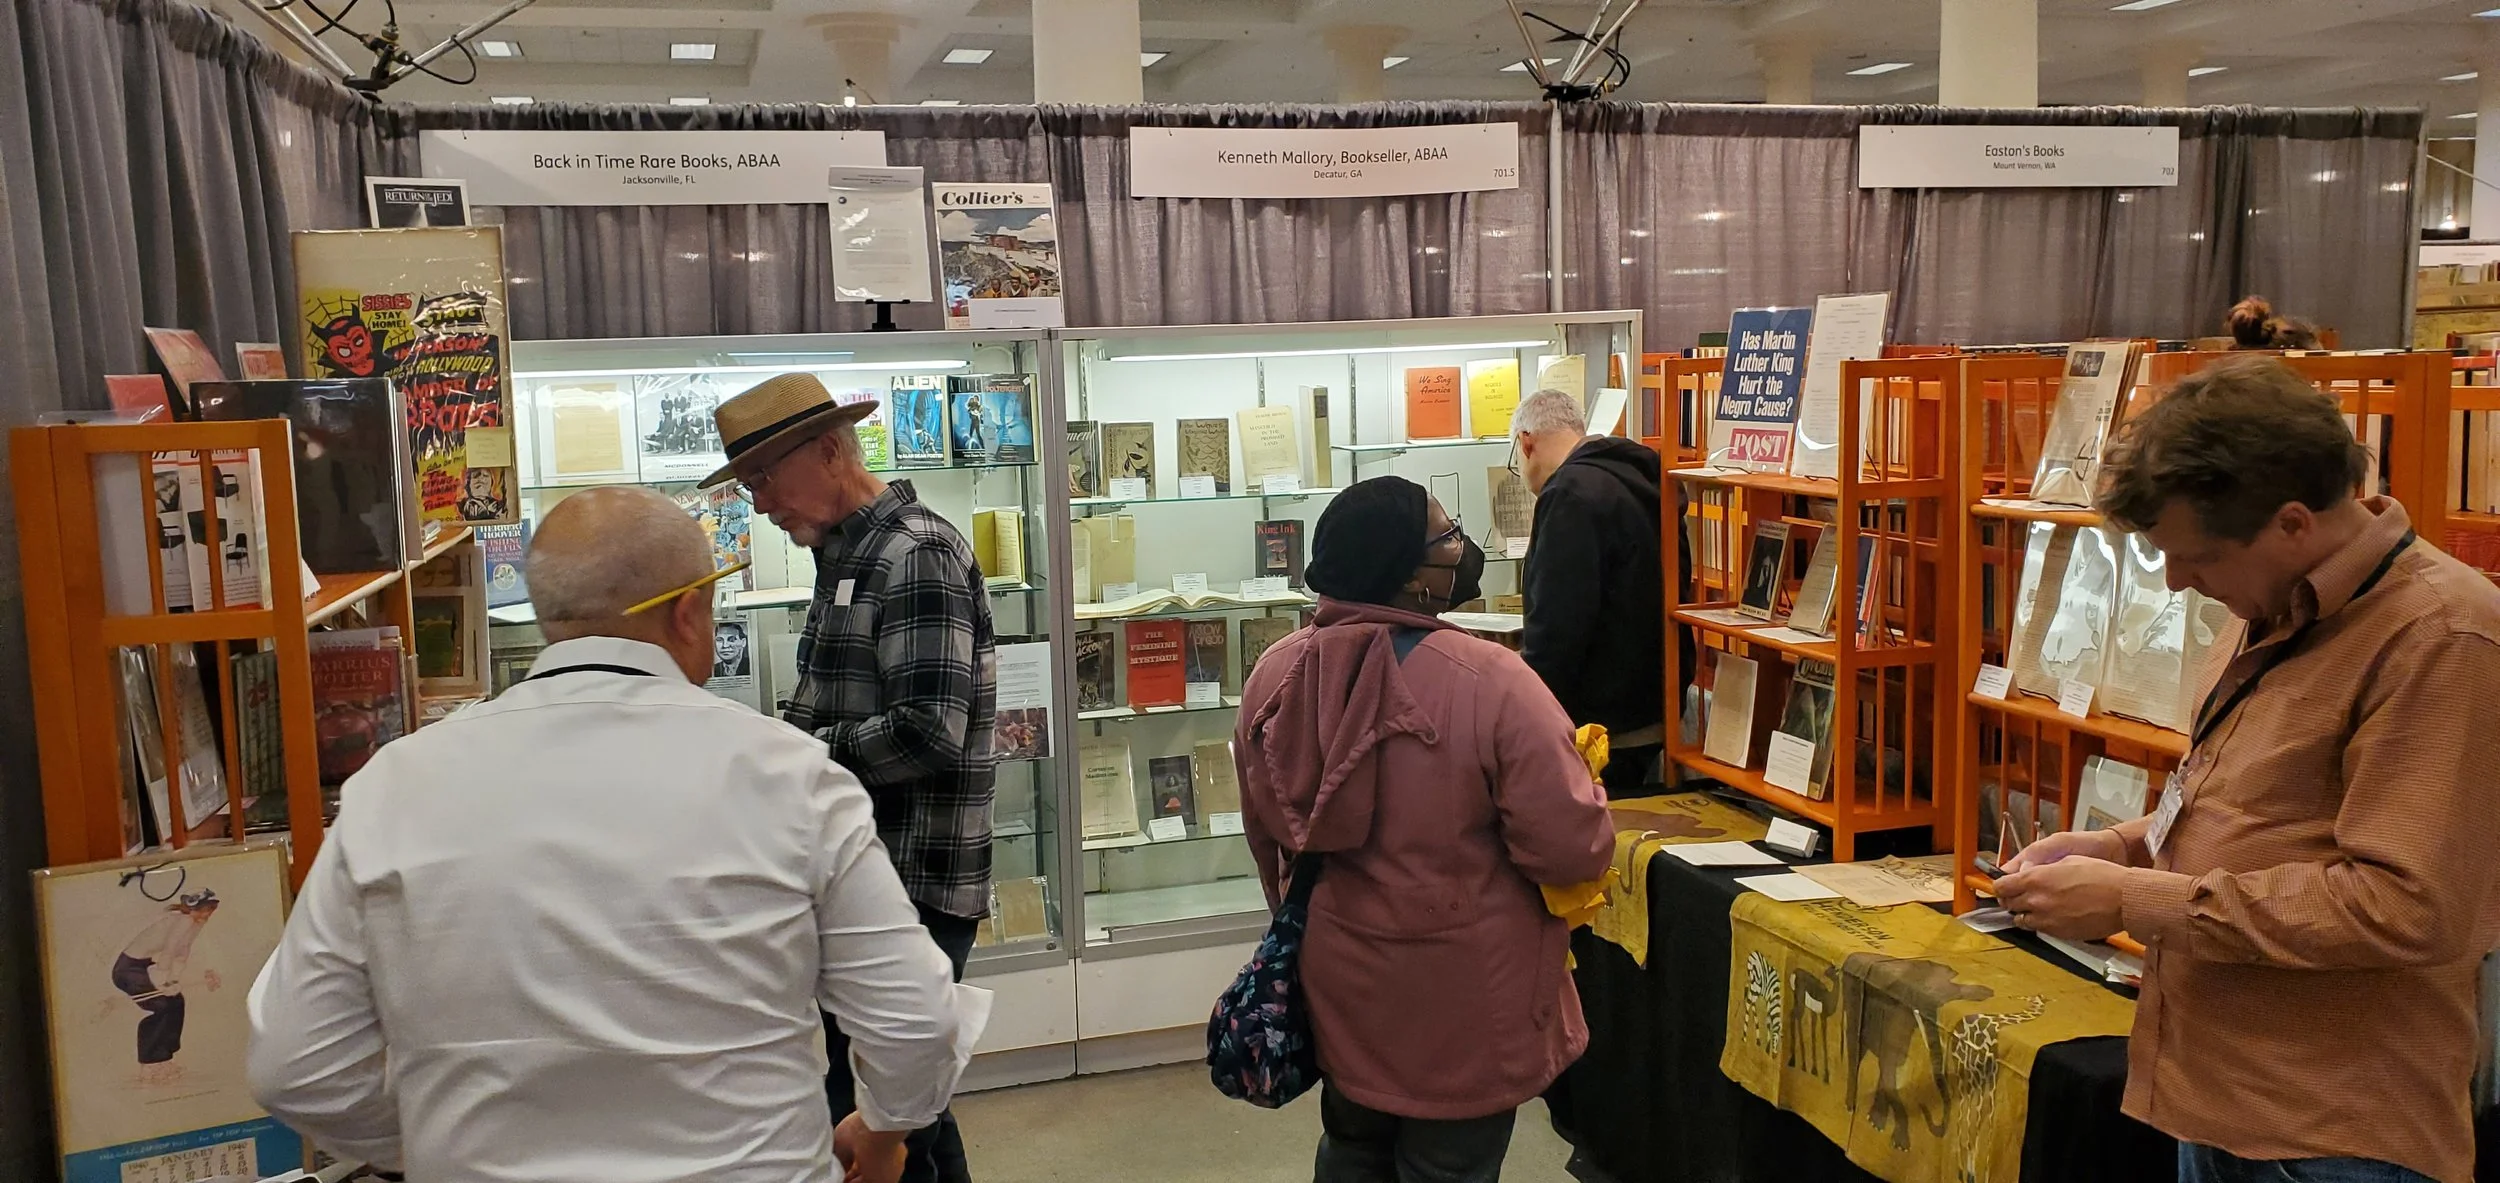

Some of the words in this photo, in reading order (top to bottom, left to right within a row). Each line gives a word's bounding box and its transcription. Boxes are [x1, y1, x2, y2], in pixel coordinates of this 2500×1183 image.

[1217, 150, 1278, 164] Kenneth
[1282, 150, 1337, 167] Mallory,
[1340, 149, 1411, 164] Bookseller,
[1414, 147, 1448, 160] ABAA
[1985, 144, 2031, 157] Easton's
[2033, 144, 2065, 157] Books
[533, 154, 571, 169] Back
[576, 154, 591, 169] in
[595, 154, 635, 169] Time
[640, 154, 676, 169] Rare
[681, 153, 732, 170] Books,
[737, 153, 781, 168] ABAA
[1993, 161, 2016, 169] Mount
[2017, 161, 2043, 171] Vernon,
[2044, 161, 2056, 169] WA
[1313, 169, 1348, 179] Decatur,
[1350, 169, 1363, 178] GA
[1493, 168, 1515, 178] 701.5
[2161, 167, 2175, 176] 702
[622, 175, 683, 185] Jacksonville,
[685, 175, 696, 184] FL
[385, 191, 425, 201] RETURN
[432, 192, 453, 207] JEDI
[941, 191, 1024, 206] Collier's
[362, 294, 412, 311] SISSIES
[375, 311, 402, 320] STAY
[372, 319, 406, 329] HOME!
[1740, 330, 1760, 351] Has
[1762, 330, 1796, 350] Martin
[417, 355, 494, 374] HOLLYWOOD
[1734, 352, 1769, 373] Luther
[1771, 354, 1795, 376] King
[892, 376, 940, 390] ALIEN
[1419, 375, 1431, 384] We
[1435, 374, 1452, 386] Sing
[1738, 375, 1763, 395] Hurt
[1765, 375, 1782, 395] the
[1420, 386, 1451, 395] America
[1720, 395, 1752, 419] Negro
[1754, 396, 1793, 417] Cause?
[1731, 432, 1786, 461] POST
[483, 530, 522, 539] HOOVER
[1256, 524, 1279, 535] King
[1280, 522, 1296, 534] Ink
[1145, 631, 1164, 639] THE
[1130, 641, 1178, 651] FEMININE
[1130, 654, 1179, 665] MYSTIQUE
[160, 1148, 214, 1166] JANUARY
